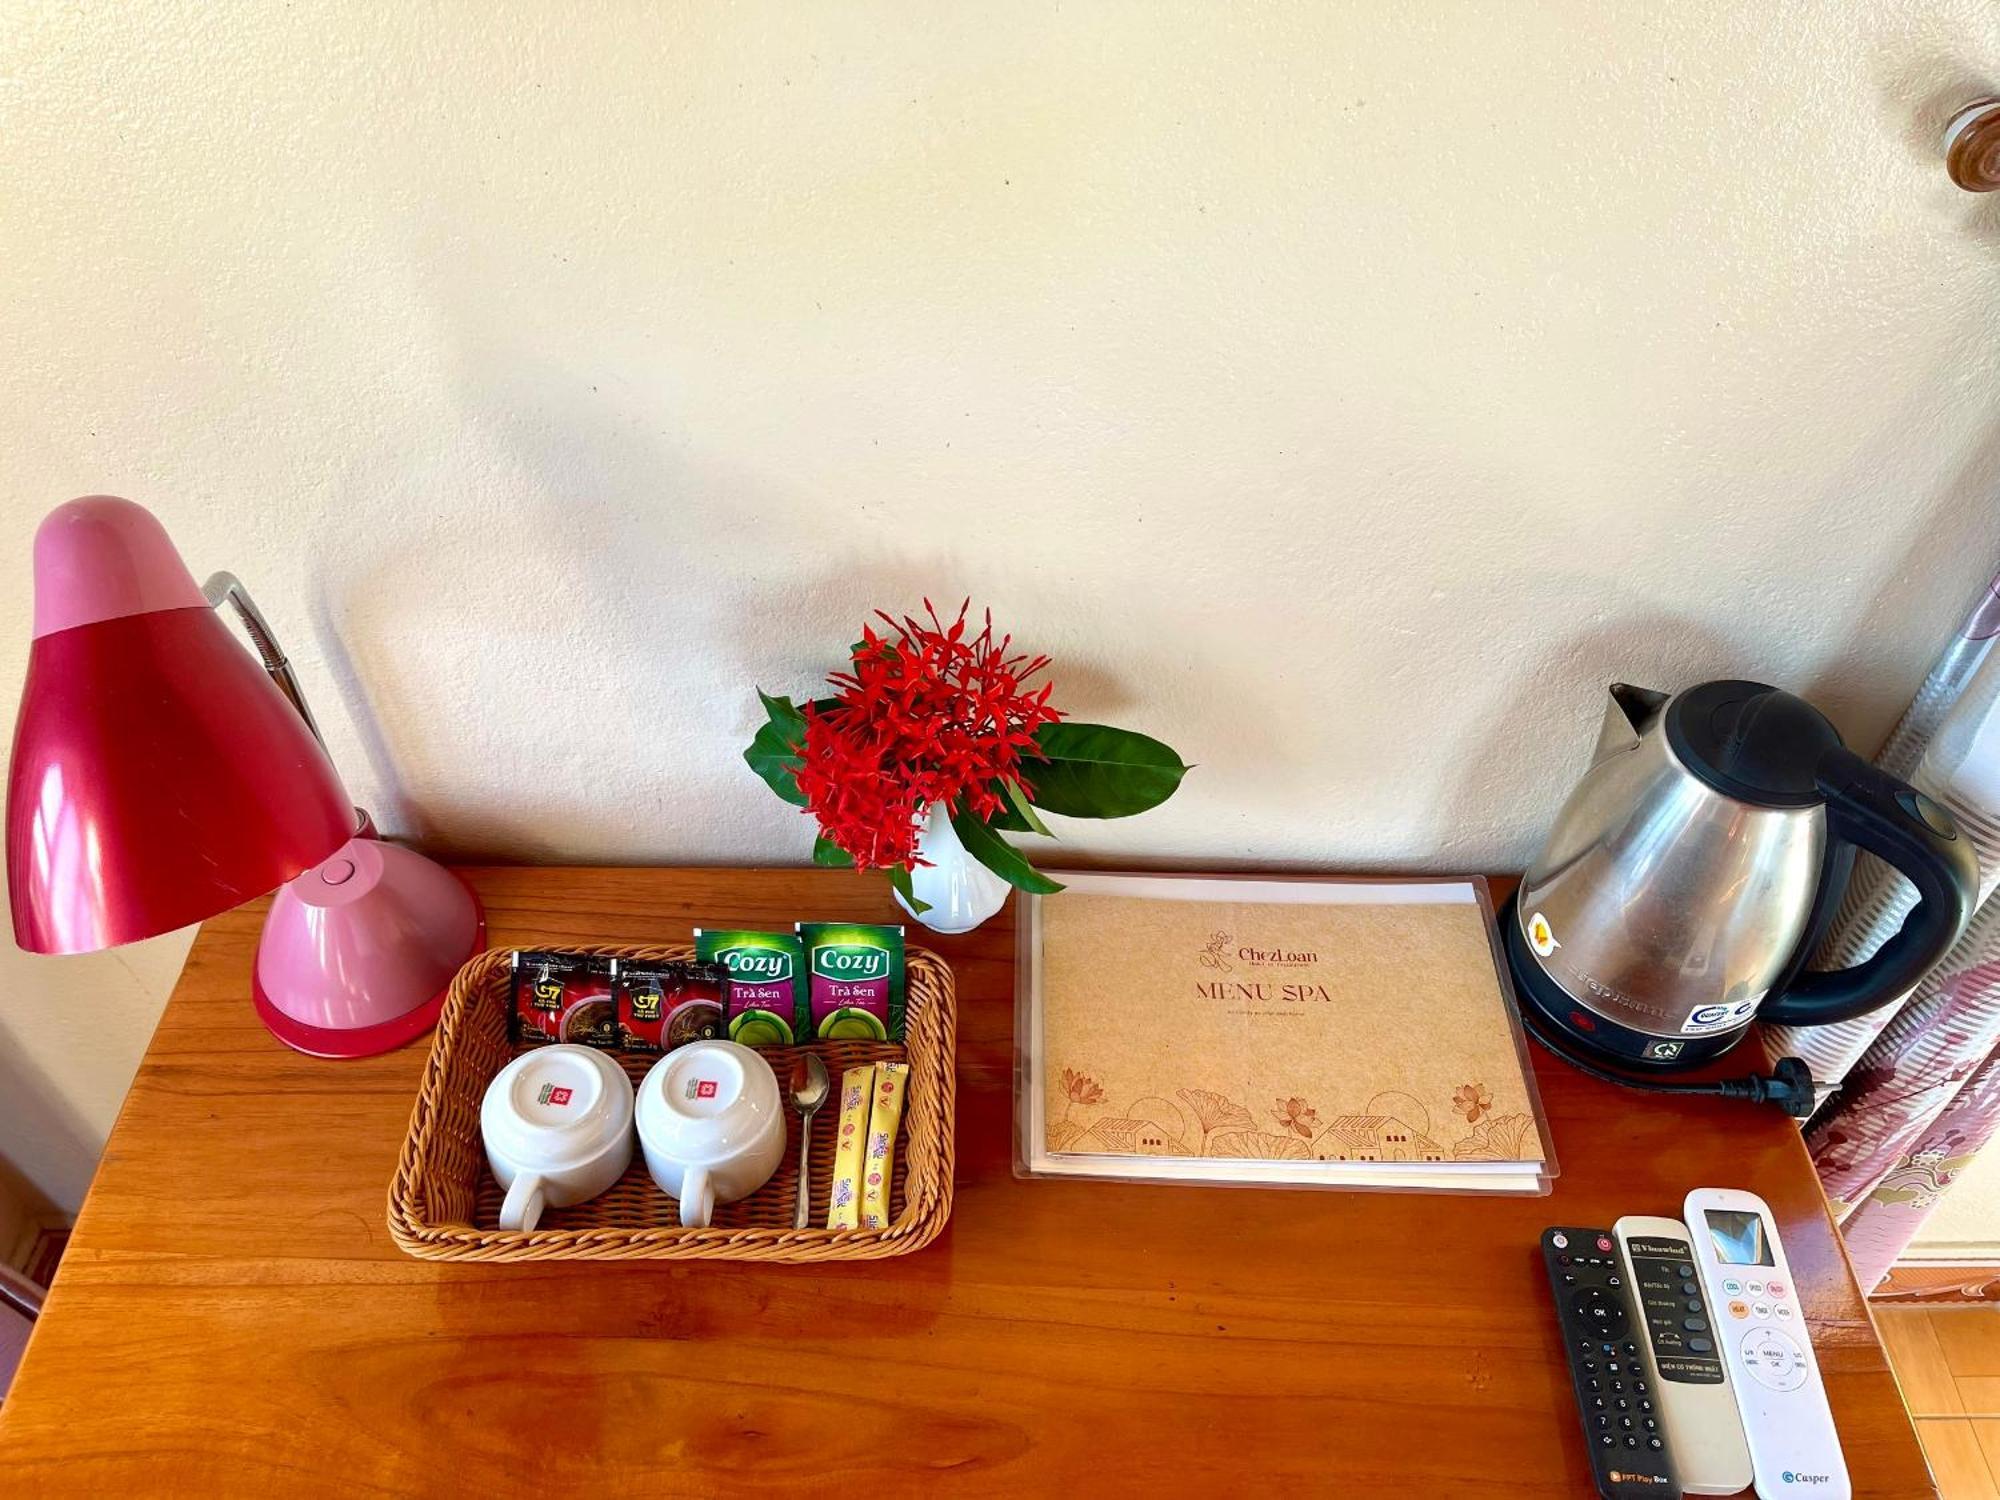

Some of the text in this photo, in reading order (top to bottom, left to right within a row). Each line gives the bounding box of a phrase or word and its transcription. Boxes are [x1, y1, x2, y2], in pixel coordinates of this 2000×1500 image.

[820, 950, 880, 974] Cozy
[1239, 947, 1318, 963] ChezLoan
[724, 952, 783, 976] Cozy
[535, 984, 561, 1000] G7
[734, 987, 780, 999] Trà Sen
[829, 984, 875, 997] Trà Sen
[1195, 982, 1332, 1002] MENU SPA
[633, 994, 660, 1010] G7
[1763, 1350, 1784, 1358] MENU
